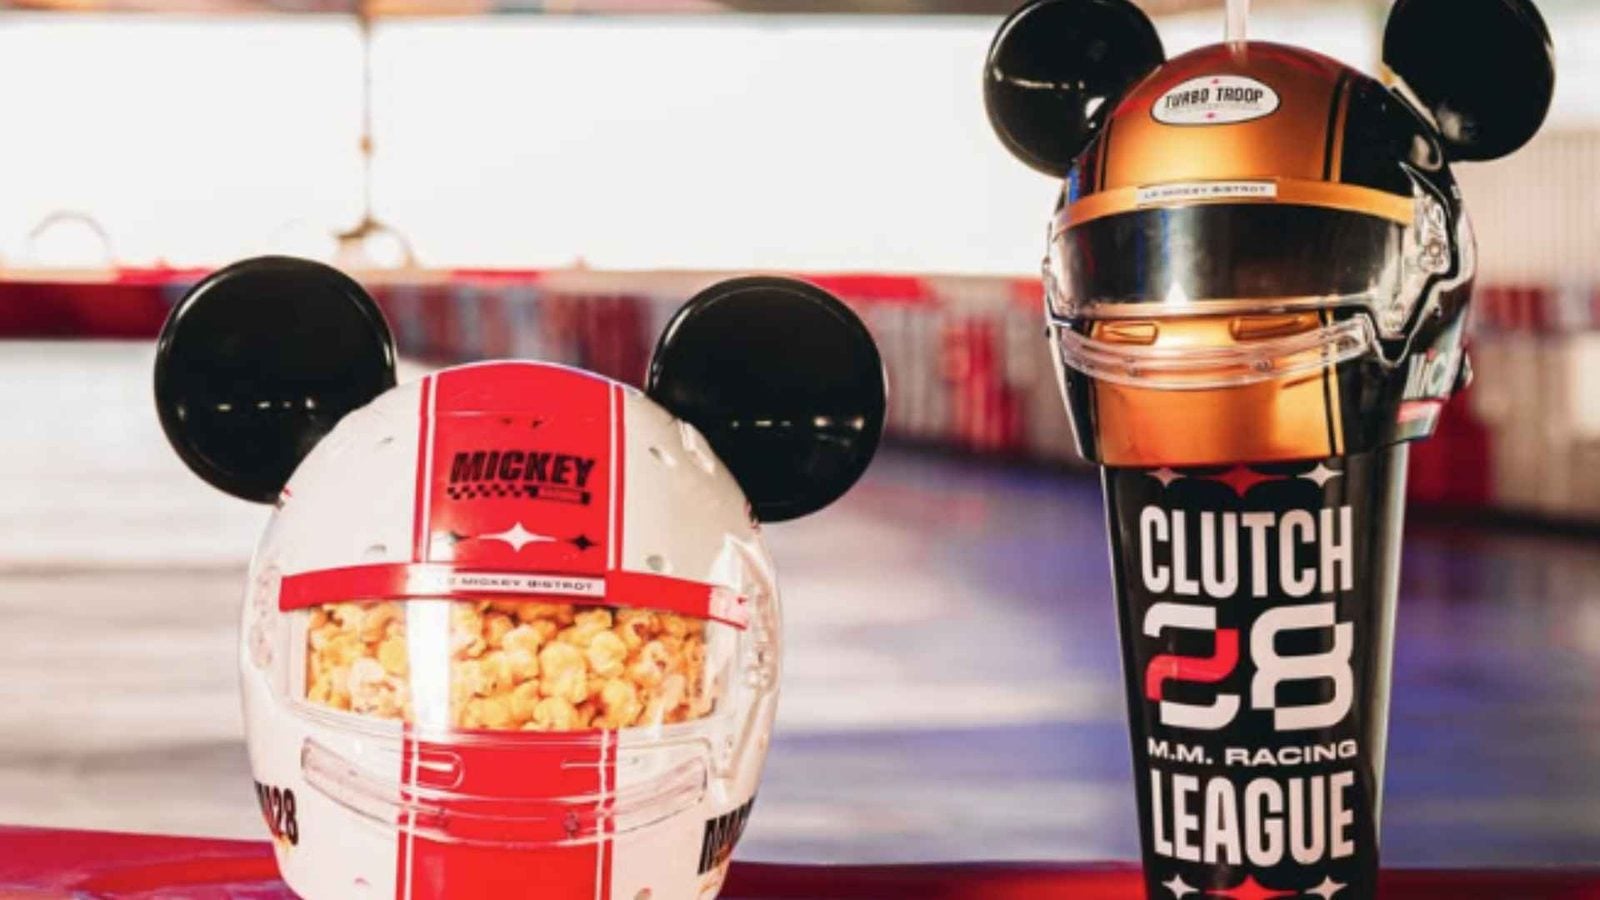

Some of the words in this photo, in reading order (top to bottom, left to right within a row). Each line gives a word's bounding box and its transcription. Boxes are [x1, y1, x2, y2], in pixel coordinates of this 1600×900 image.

[1217, 87, 1263, 103] TROOP
[450, 451, 595, 486] MICKEY
[1139, 504, 1354, 599] CLUTCH
[1143, 601, 1354, 732] 28
[1147, 736, 1214, 765] M.M.
[1224, 739, 1359, 766] RACING
[1150, 767, 1355, 868] LEAGUE
